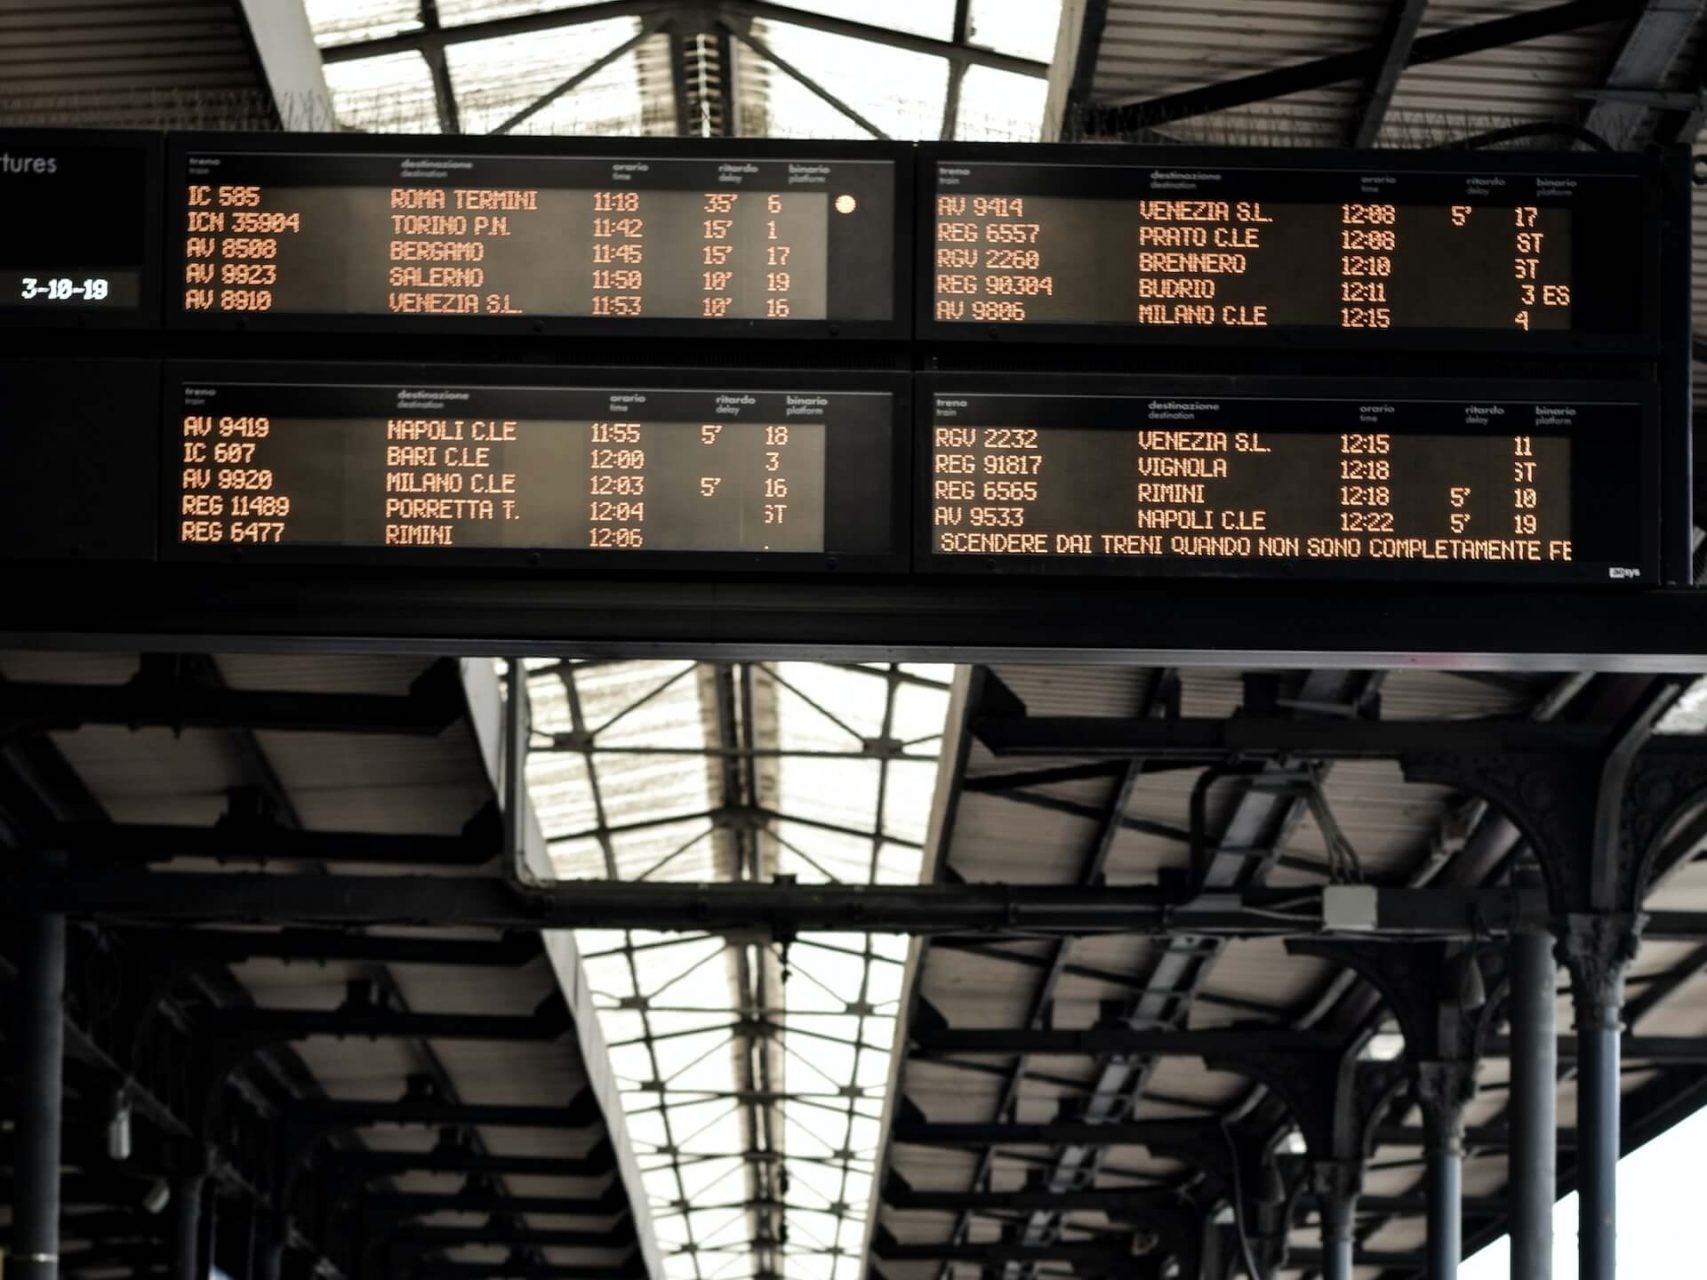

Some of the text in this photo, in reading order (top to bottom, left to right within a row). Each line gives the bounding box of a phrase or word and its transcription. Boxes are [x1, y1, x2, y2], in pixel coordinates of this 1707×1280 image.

[188, 185, 212, 206] IC
[390, 188, 446, 209] ROMA
[453, 189, 538, 210] TERMINI
[593, 191, 639, 212] 11:18
[767, 194, 782, 214] 6
[937, 195, 966, 216] AV
[973, 197, 1023, 217] 9414
[1139, 200, 1229, 221] VENEZIA
[1236, 201, 1273, 223] S.L.
[1342, 204, 1396, 225] 12:08
[1514, 206, 1538, 227] 17
[187, 211, 224, 232] ICN
[391, 214, 467, 235] TORINO
[474, 216, 511, 236] P.N.
[593, 218, 643, 238] 11:42
[767, 220, 777, 240] 1
[937, 222, 1544, 253] REG 6557 PRATO C.LE 12:08 ST
[186, 237, 215, 258] AV
[390, 240, 484, 262] BERGAMO
[593, 244, 642, 264] 11:45
[767, 246, 790, 265] 17
[937, 248, 978, 268] RGV
[986, 249, 1040, 270] 2260
[1138, 252, 1247, 274] BRENNERO
[1341, 255, 1391, 277] 12:10
[186, 263, 214, 284] AV
[389, 266, 484, 287] SALERNO
[592, 269, 642, 290] 11:50
[767, 272, 790, 292] 19
[937, 274, 1570, 306] REG 90304 BUDRIO 12:11 3 ES
[185, 289, 214, 310] AV
[388, 292, 479, 314] VENEZIA
[486, 294, 523, 314] S.L.
[592, 295, 642, 316] 11:53
[767, 298, 790, 318] 16
[936, 300, 1529, 331] AV 9806 MILANO C.LE 12:15 4
[716, 394, 756, 404] ritardo
[786, 395, 828, 405] binario
[937, 399, 1576, 415] treno destinazione orario ritardo binario
[183, 416, 212, 437] AV
[219, 416, 270, 438] 9419
[386, 419, 465, 441] NAPOLI
[471, 421, 517, 441] C.LE
[591, 423, 641, 443] 11:55
[765, 425, 789, 446] 18
[935, 427, 1533, 457] RGV 2232 VENEZIA S.L. 12:15 11
[183, 442, 779, 471] IC 607 BARI C.LE 12:00 3
[935, 454, 976, 474] REG
[983, 454, 1043, 475] 91817
[1138, 456, 1227, 478] VIGNOLA
[1340, 459, 1390, 480] 12:18
[182, 468, 211, 489] AV
[218, 469, 273, 490] 9920
[386, 472, 463, 493] MILANO
[470, 473, 516, 494] C.LE
[590, 475, 644, 496] 12:03
[765, 478, 788, 498] 16
[934, 480, 975, 500] REG
[983, 481, 1038, 501] 6565
[1137, 482, 1205, 504] RIMINI
[1340, 485, 1390, 506] 12:18
[1514, 487, 1537, 509] 10
[182, 494, 223, 516] REG
[231, 495, 290, 517] 11489
[385, 498, 494, 520] PORRETTA
[590, 501, 644, 522] 12:04
[934, 506, 962, 526] AV
[970, 507, 1025, 527] 9533
[1137, 509, 1214, 530] NAPOLI
[1221, 510, 1267, 531] C.LE
[1340, 511, 1394, 533] 12:22
[1514, 514, 1537, 535] 19
[181, 520, 644, 548] REG 6477 RIMINI 12:06
[940, 532, 1049, 553] SCENDERE
[1055, 533, 1093, 554] DAI
[1100, 534, 1163, 555] TRENI
[1170, 535, 1251, 556] QUANDO
[1258, 536, 1299, 557] NON
[1307, 537, 1361, 558] SONO
[1369, 538, 1541, 561] COMPLETAMENTE
